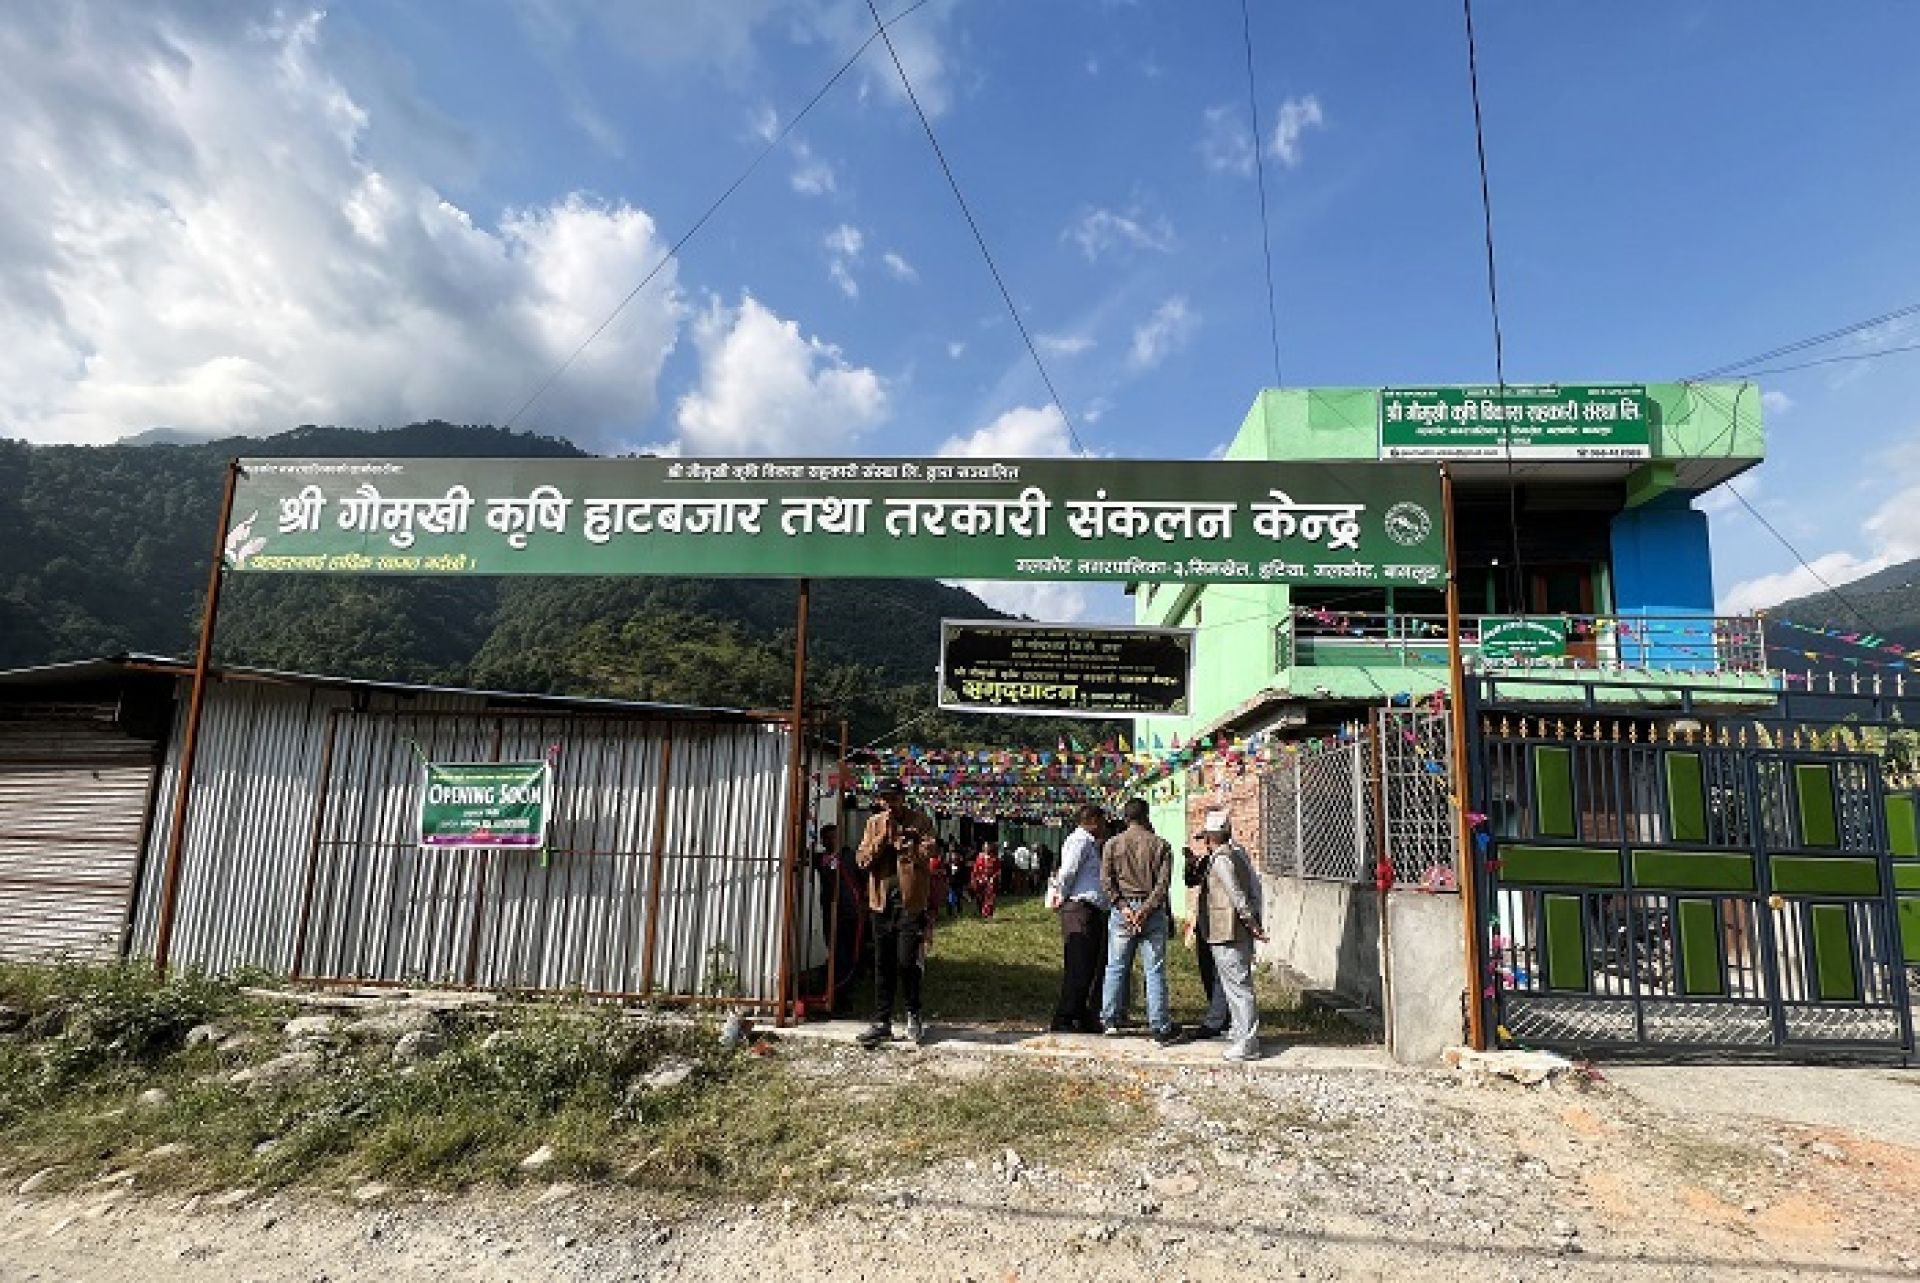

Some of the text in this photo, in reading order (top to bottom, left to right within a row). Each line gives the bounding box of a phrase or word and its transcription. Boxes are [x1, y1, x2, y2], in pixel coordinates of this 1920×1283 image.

[278, 484, 327, 534] श्री
[337, 483, 476, 548] गौमुखी
[485, 484, 574, 548] कृषि
[583, 498, 769, 544] हाटबजार
[780, 497, 873, 537] तथा
[885, 485, 1052, 538] तरकारी
[1065, 488, 1238, 541] संकलन
[1250, 488, 1367, 550] केन्द्र
